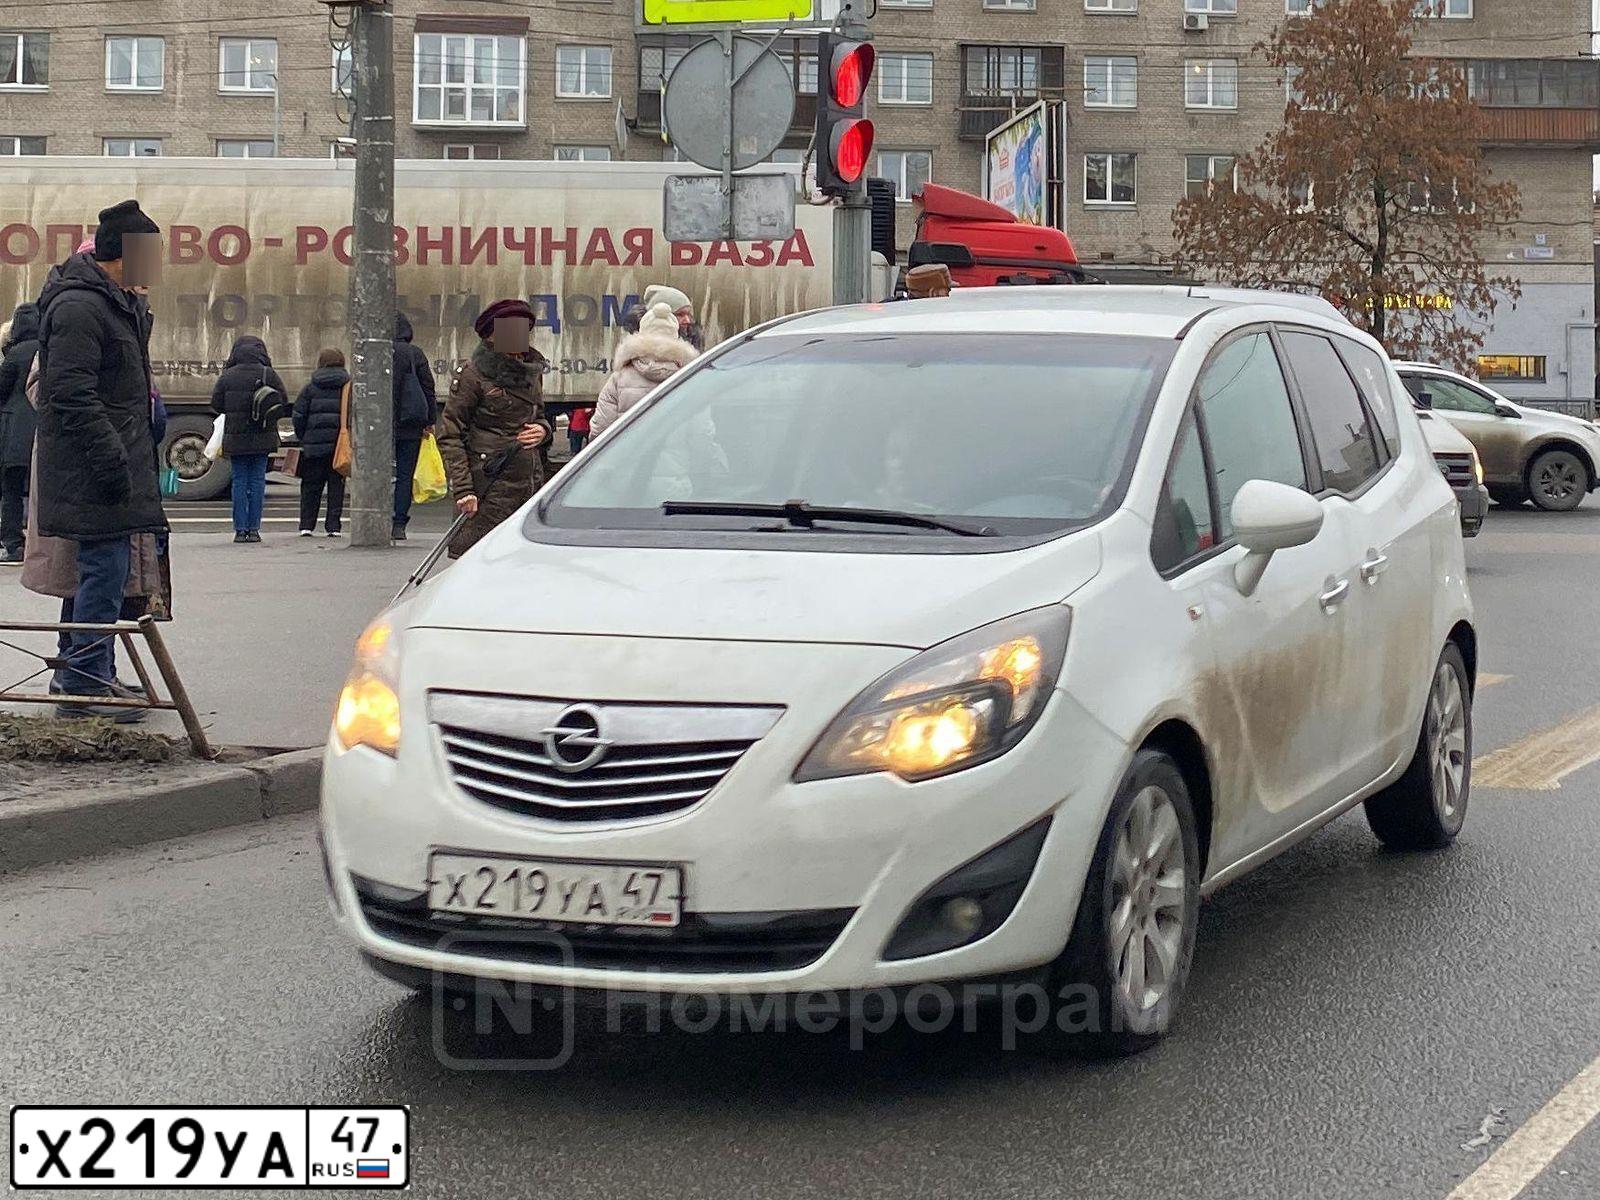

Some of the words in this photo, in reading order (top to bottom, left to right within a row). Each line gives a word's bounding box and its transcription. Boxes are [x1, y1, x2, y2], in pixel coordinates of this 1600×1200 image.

[670, 228, 815, 267] БАЗА
[176, 288, 482, 328] ТОРГОЫЙ
[529, 293, 641, 335] ДОМ
[446, 865, 608, 917] Х219УА
[623, 872, 663, 906] 47
